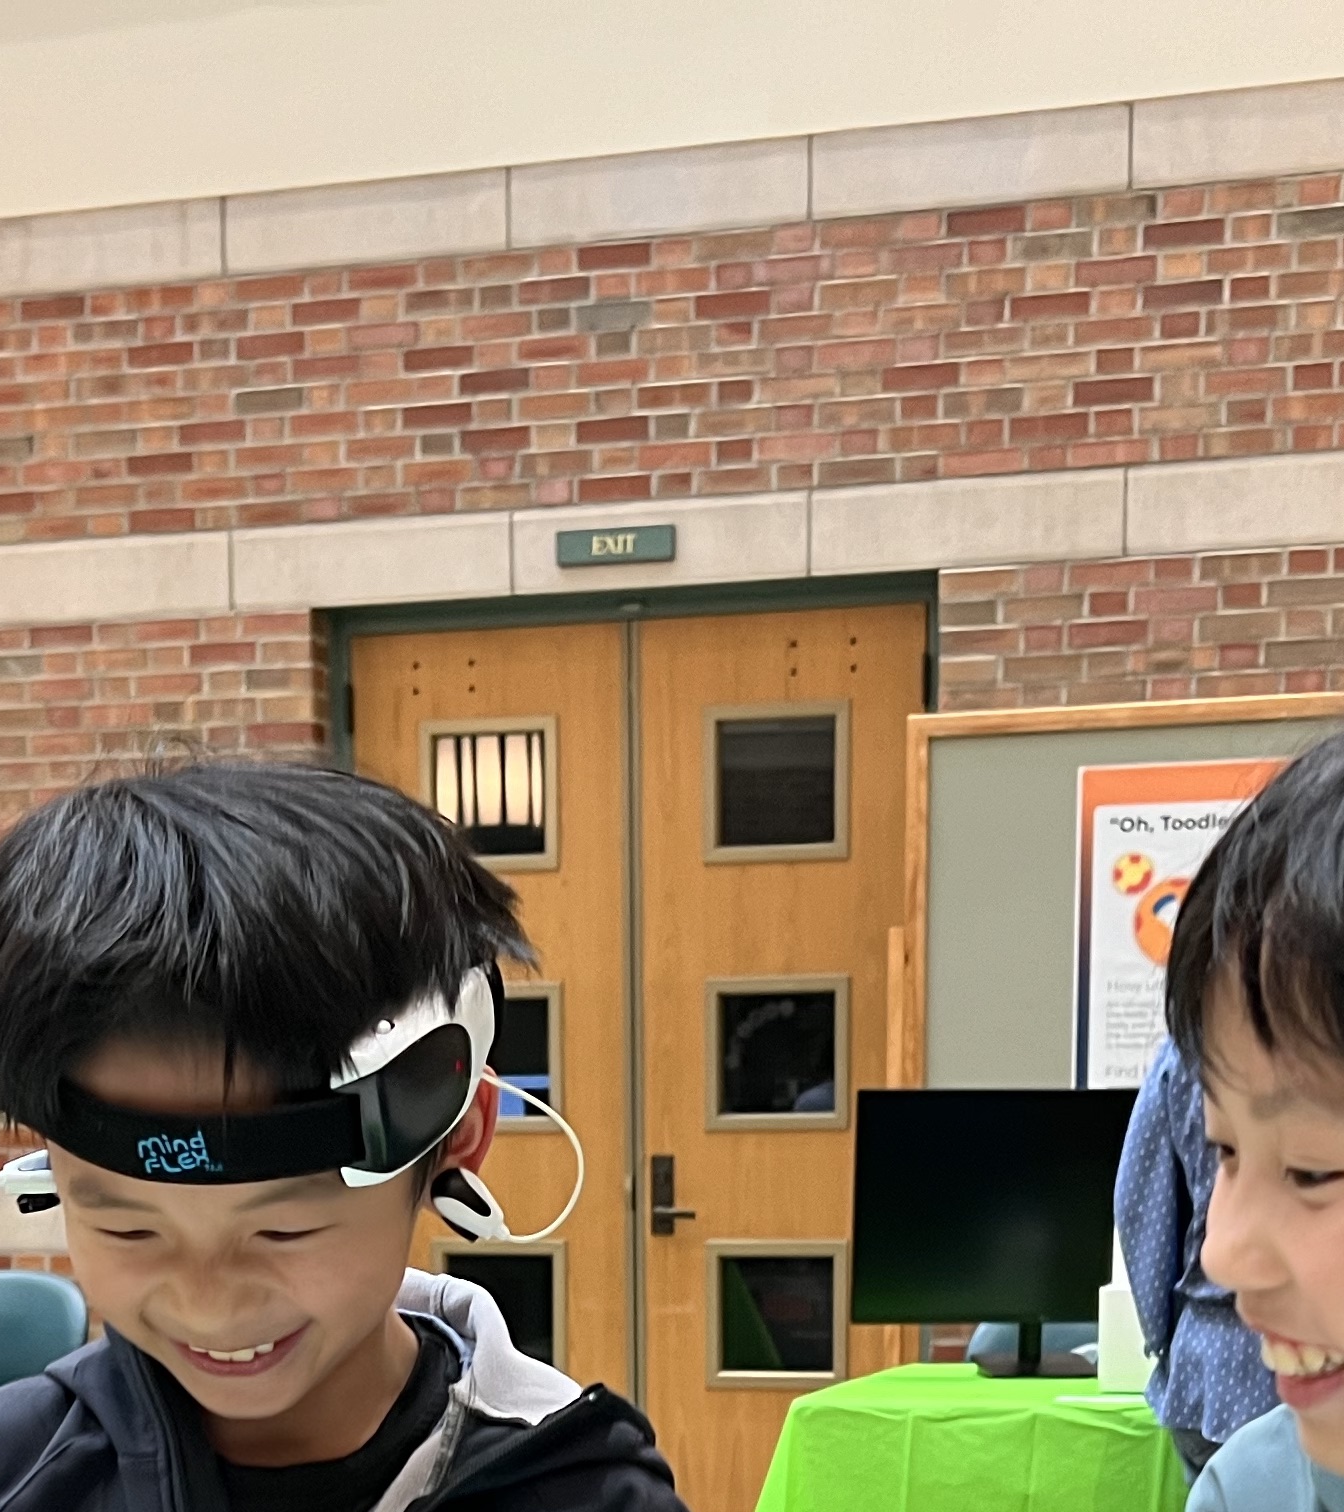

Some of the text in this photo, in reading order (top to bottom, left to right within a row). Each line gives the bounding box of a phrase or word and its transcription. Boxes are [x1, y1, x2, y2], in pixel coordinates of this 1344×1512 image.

[591, 533, 635, 556] EXIT
[1109, 816, 1155, 833] "Oh,
[138, 1129, 206, 1158] mind
